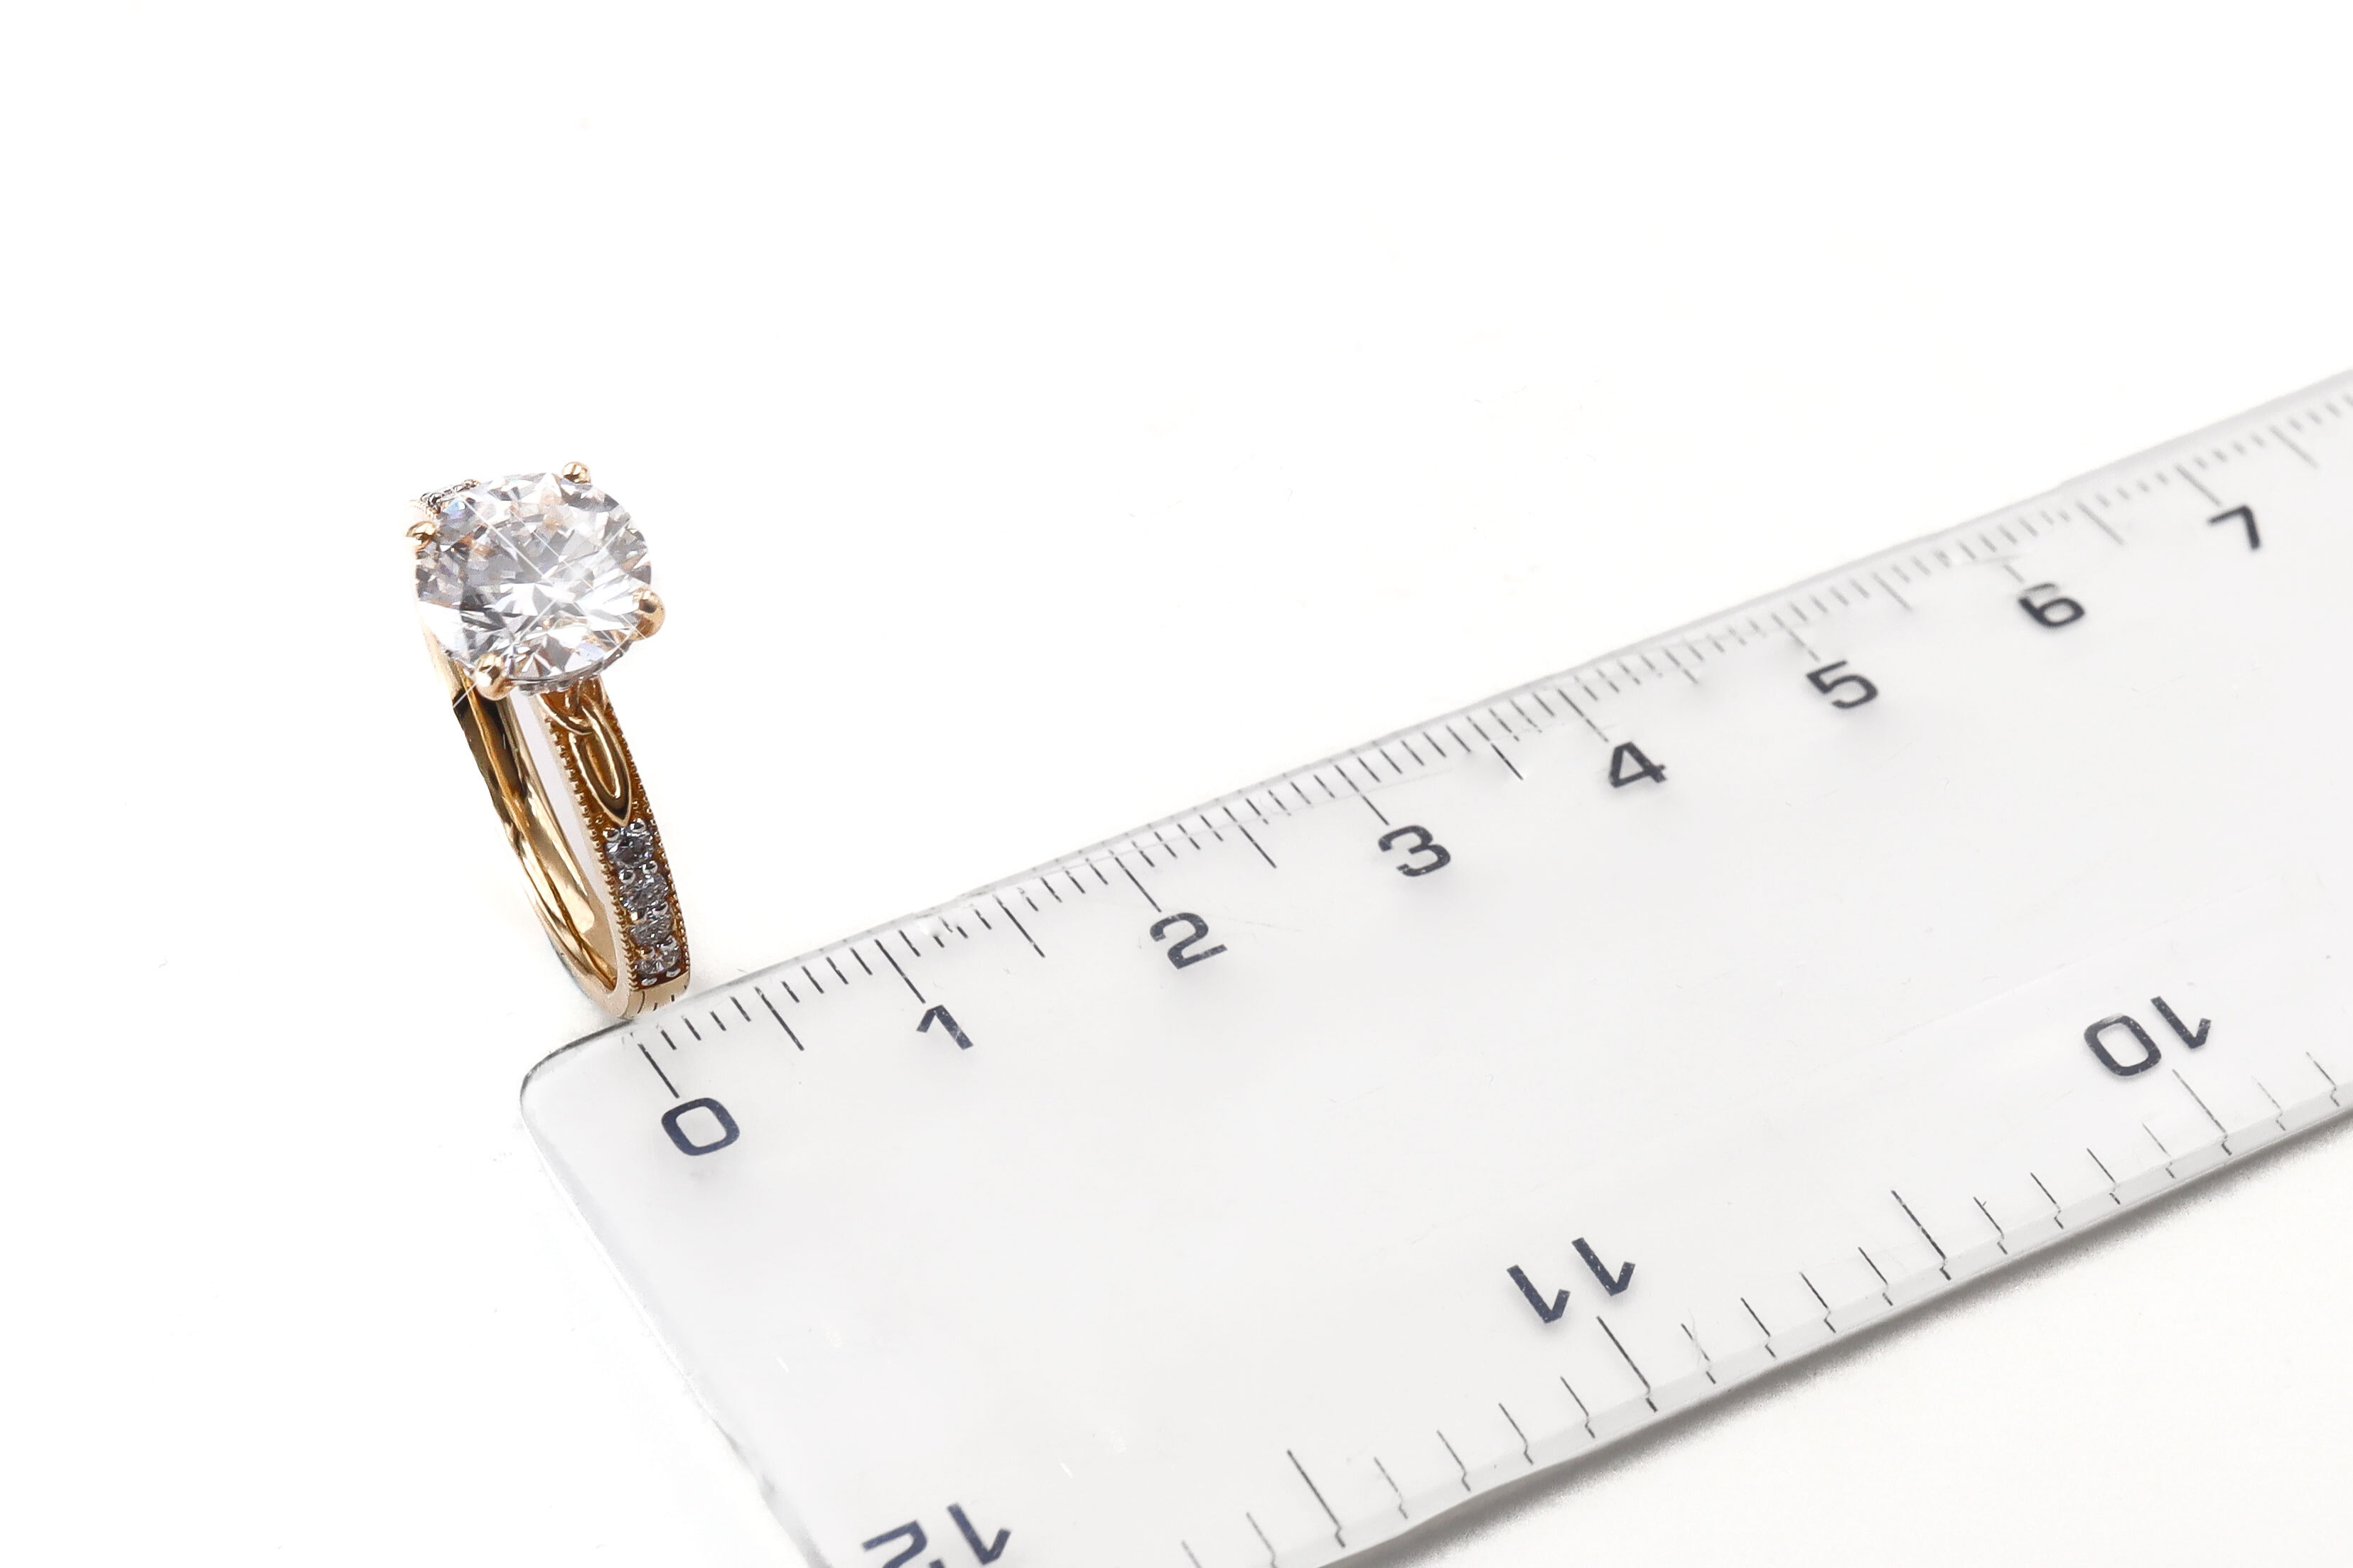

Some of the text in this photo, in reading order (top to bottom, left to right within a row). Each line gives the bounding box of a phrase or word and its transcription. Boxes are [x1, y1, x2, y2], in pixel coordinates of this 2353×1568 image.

[661, 505, 2262, 1156] 0 1 2 3 4 5 6 7
[862, 996, 2212, 1568] 10 11 12
